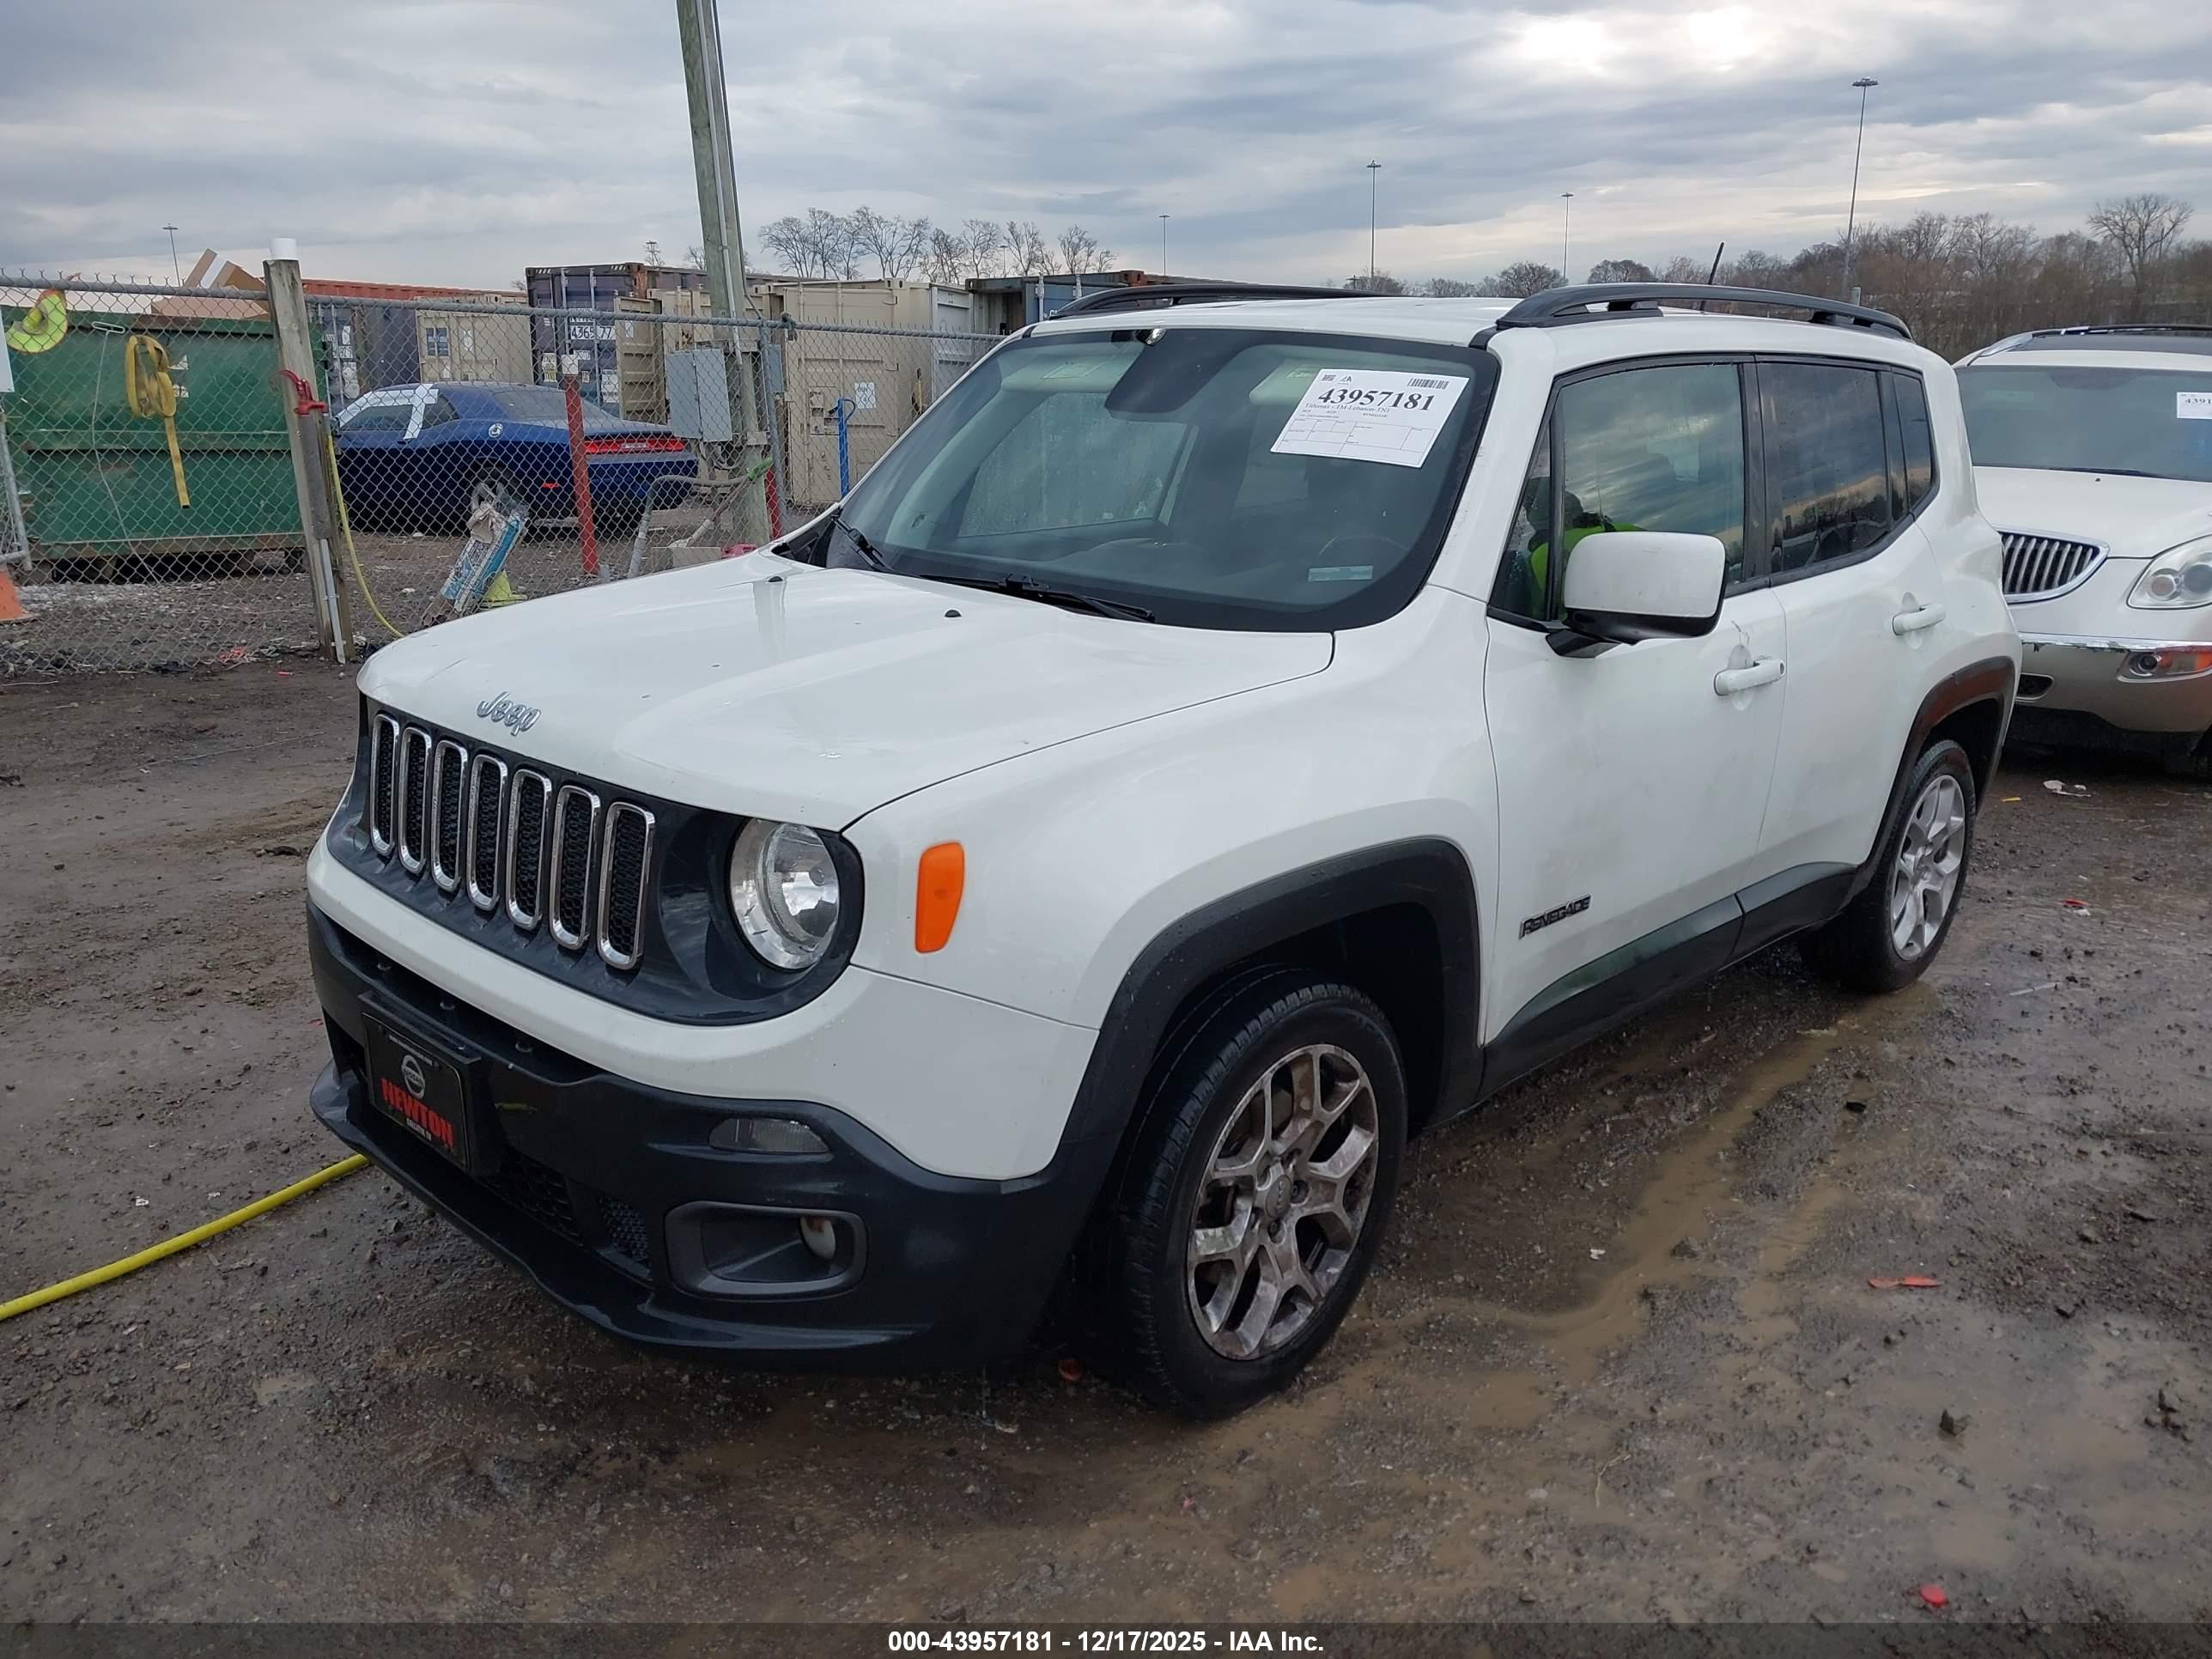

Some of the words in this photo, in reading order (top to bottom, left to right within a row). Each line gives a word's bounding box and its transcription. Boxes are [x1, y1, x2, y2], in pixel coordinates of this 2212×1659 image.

[1317, 387, 1436, 411] 43957181
[477, 691, 541, 736] Jeep
[1519, 894, 1591, 940] RENEGADE
[380, 1078, 453, 1148] NEWTON
